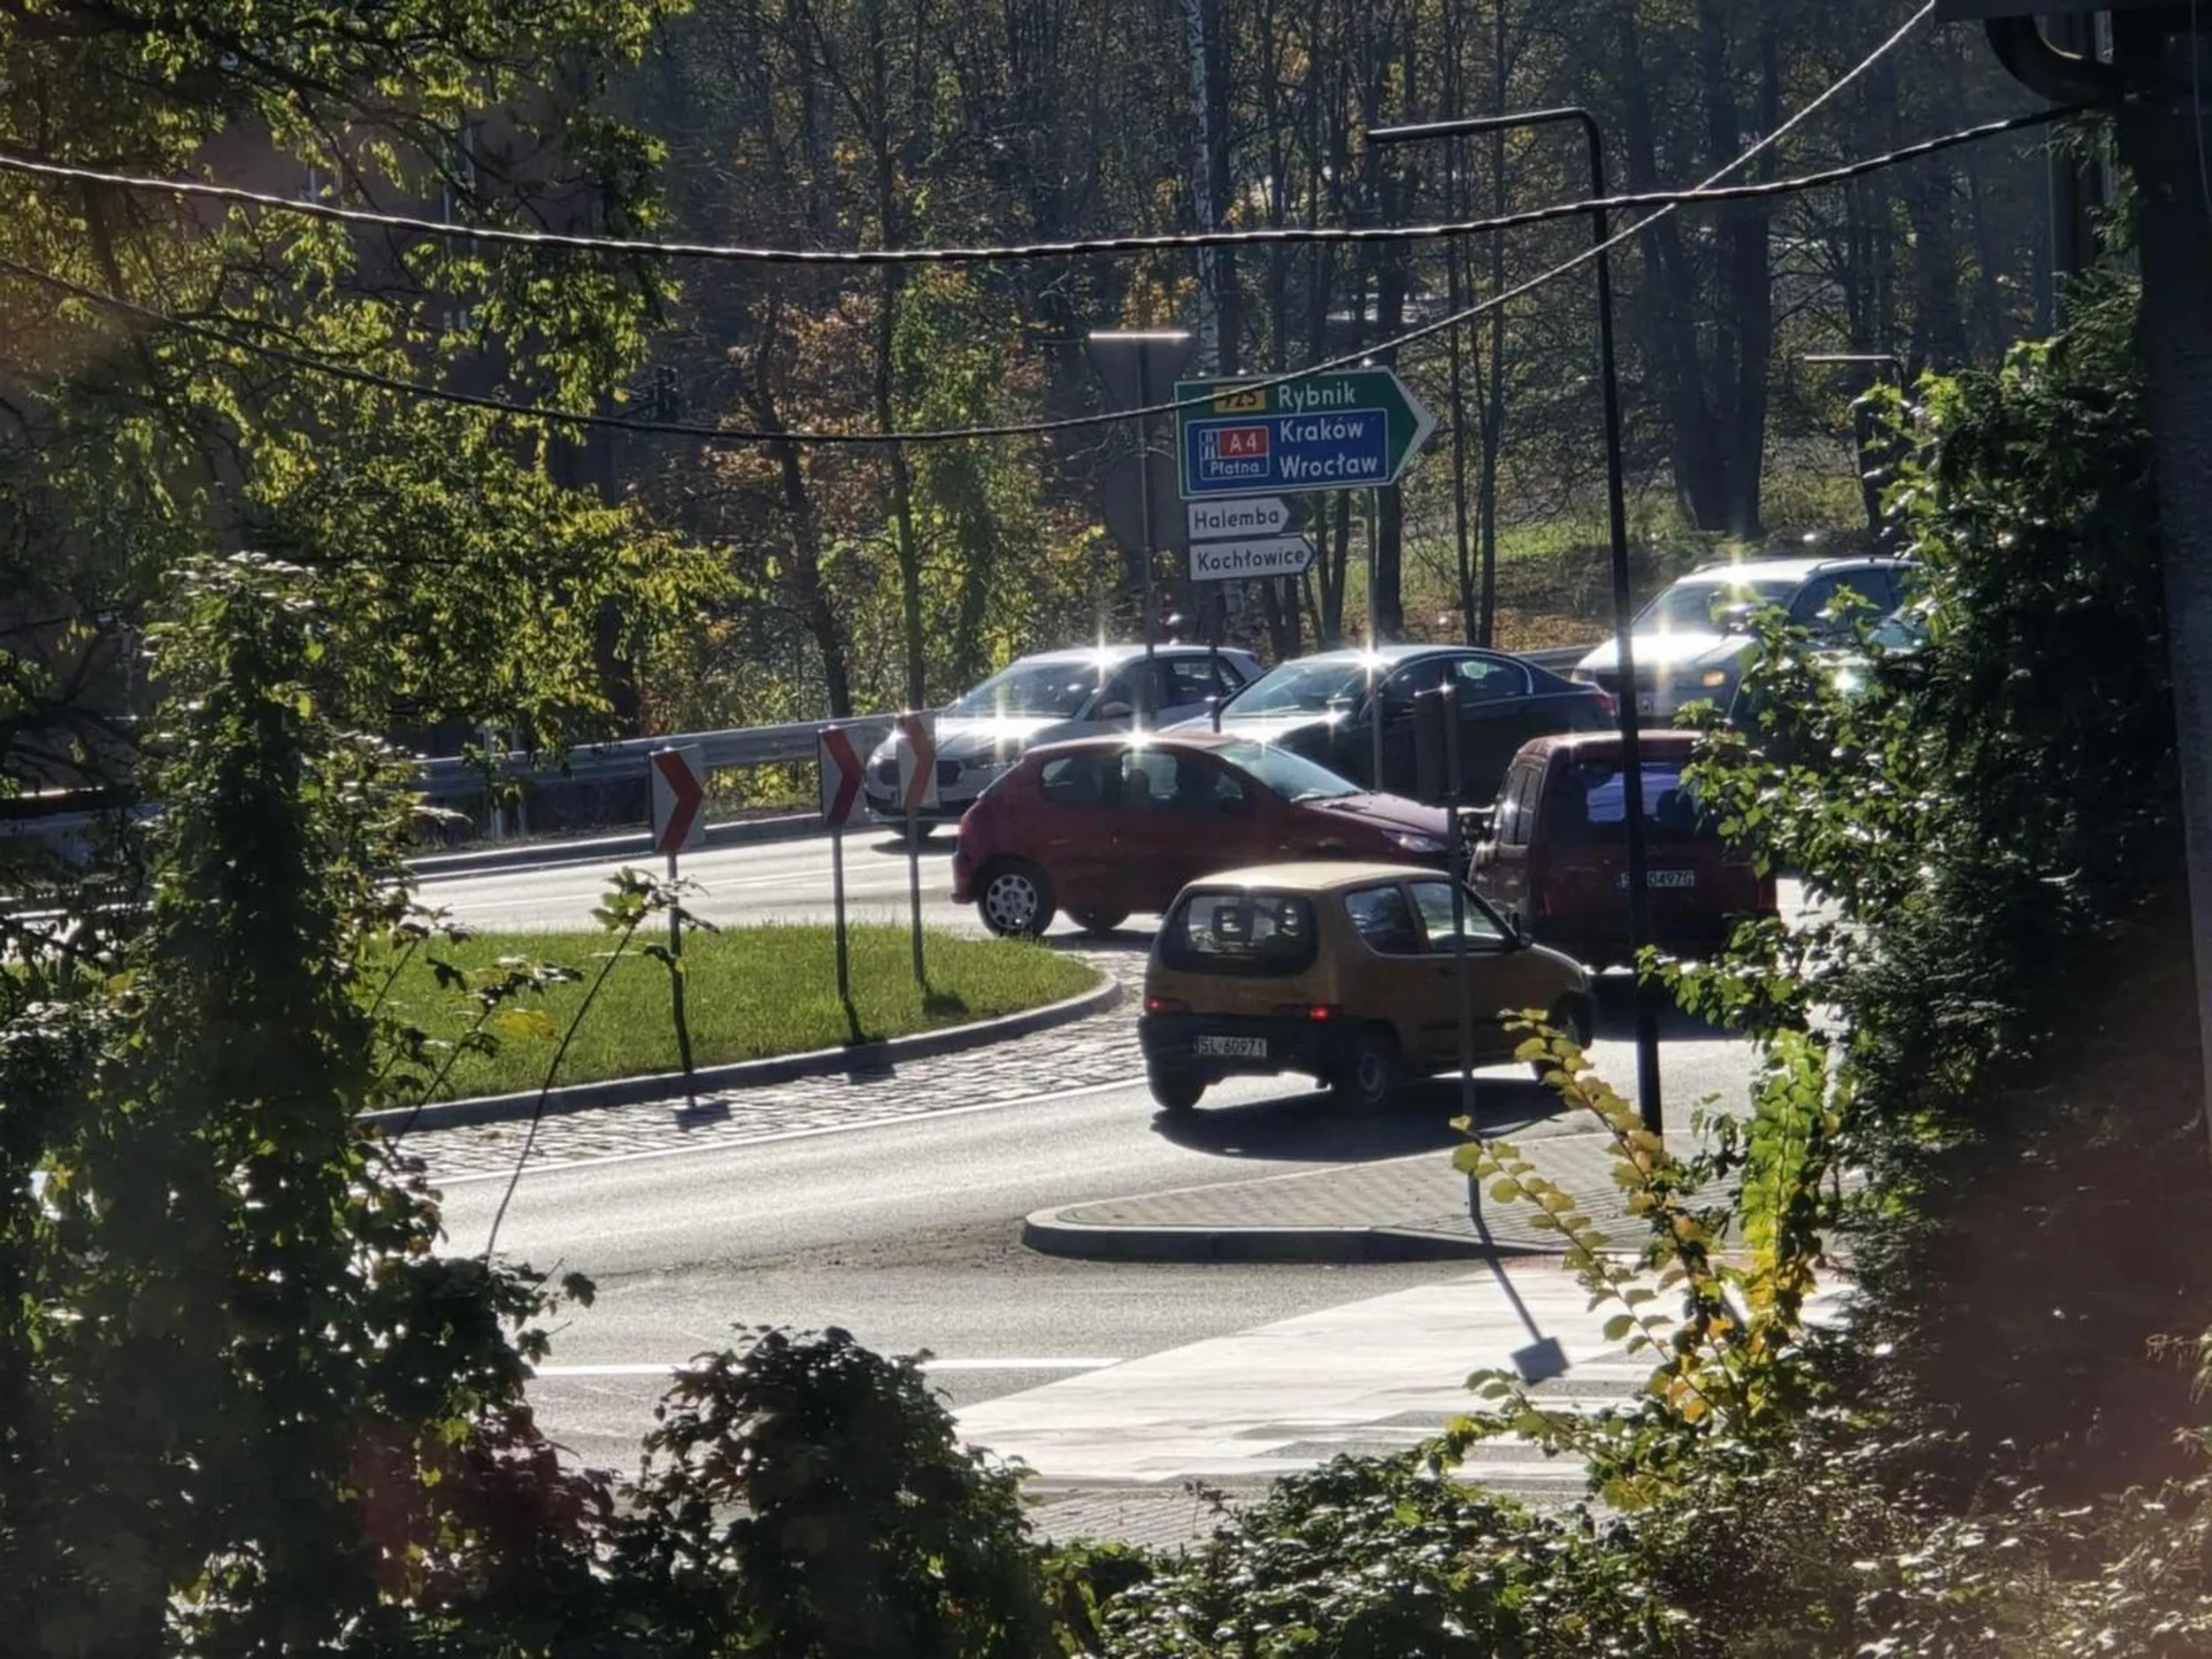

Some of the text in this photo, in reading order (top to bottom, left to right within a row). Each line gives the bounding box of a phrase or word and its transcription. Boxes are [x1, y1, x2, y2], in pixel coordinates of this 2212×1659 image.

[1278, 382, 1356, 413] Rybnik
[1279, 418, 1364, 443] Kraków
[1279, 456, 1378, 480] Wrocław
[1194, 507, 1279, 530] Halemba
[1197, 549, 1305, 573] Kochłowice
